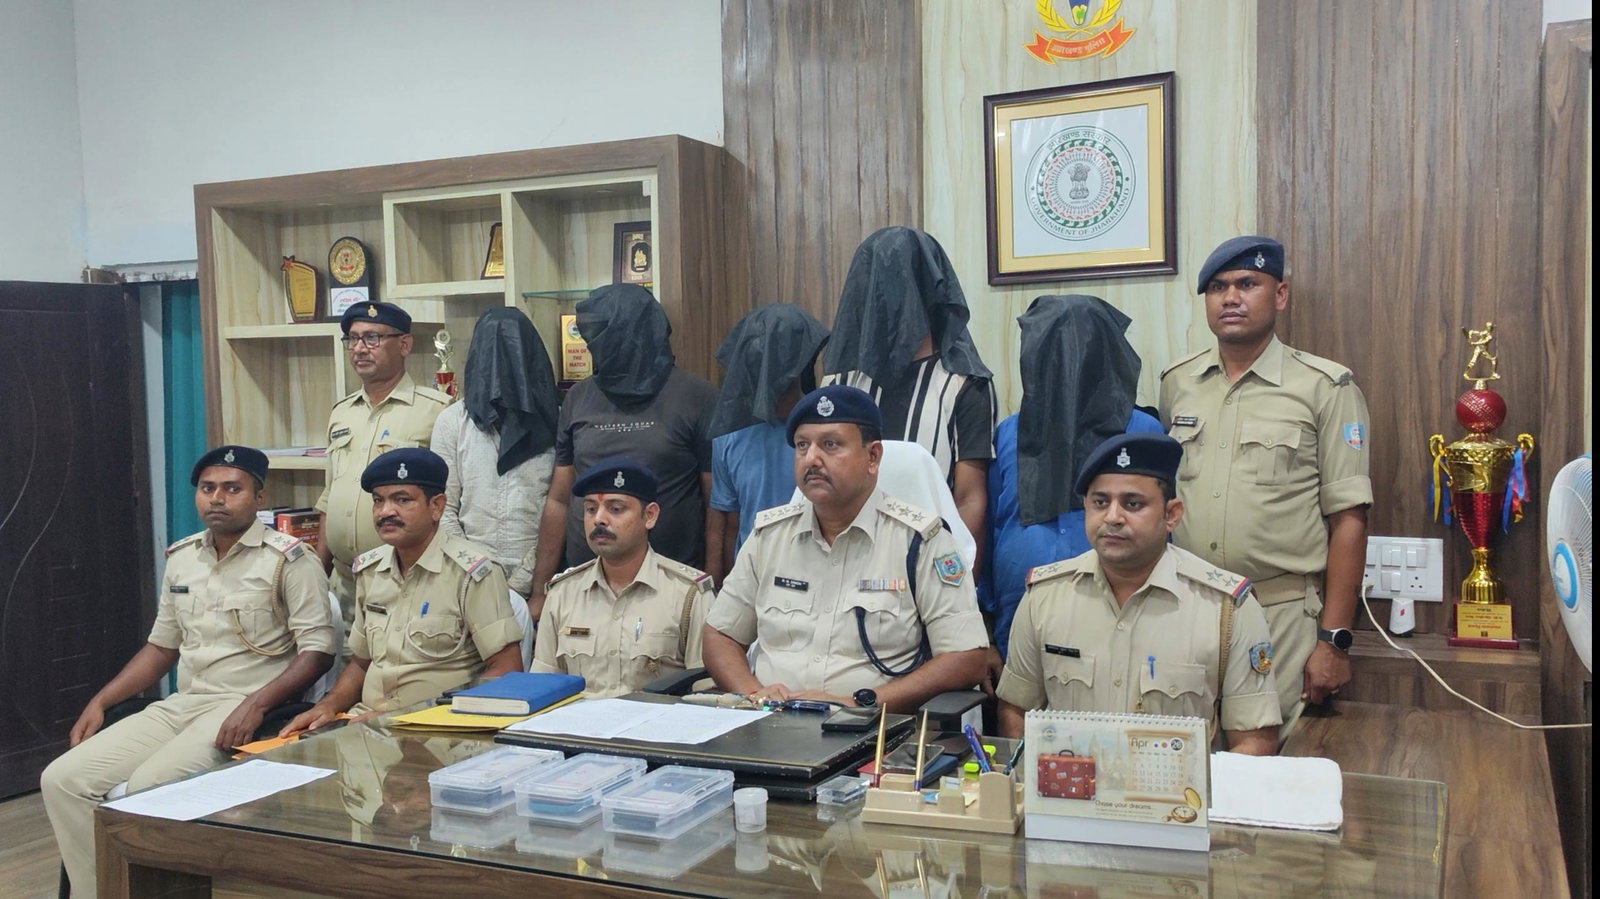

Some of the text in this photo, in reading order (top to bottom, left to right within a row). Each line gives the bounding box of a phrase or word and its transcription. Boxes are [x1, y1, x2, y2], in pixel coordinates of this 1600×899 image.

[1031, 187, 1130, 236] GOVERNMENT OF JHARKHAND
[1131, 737, 1148, 749] Apr
